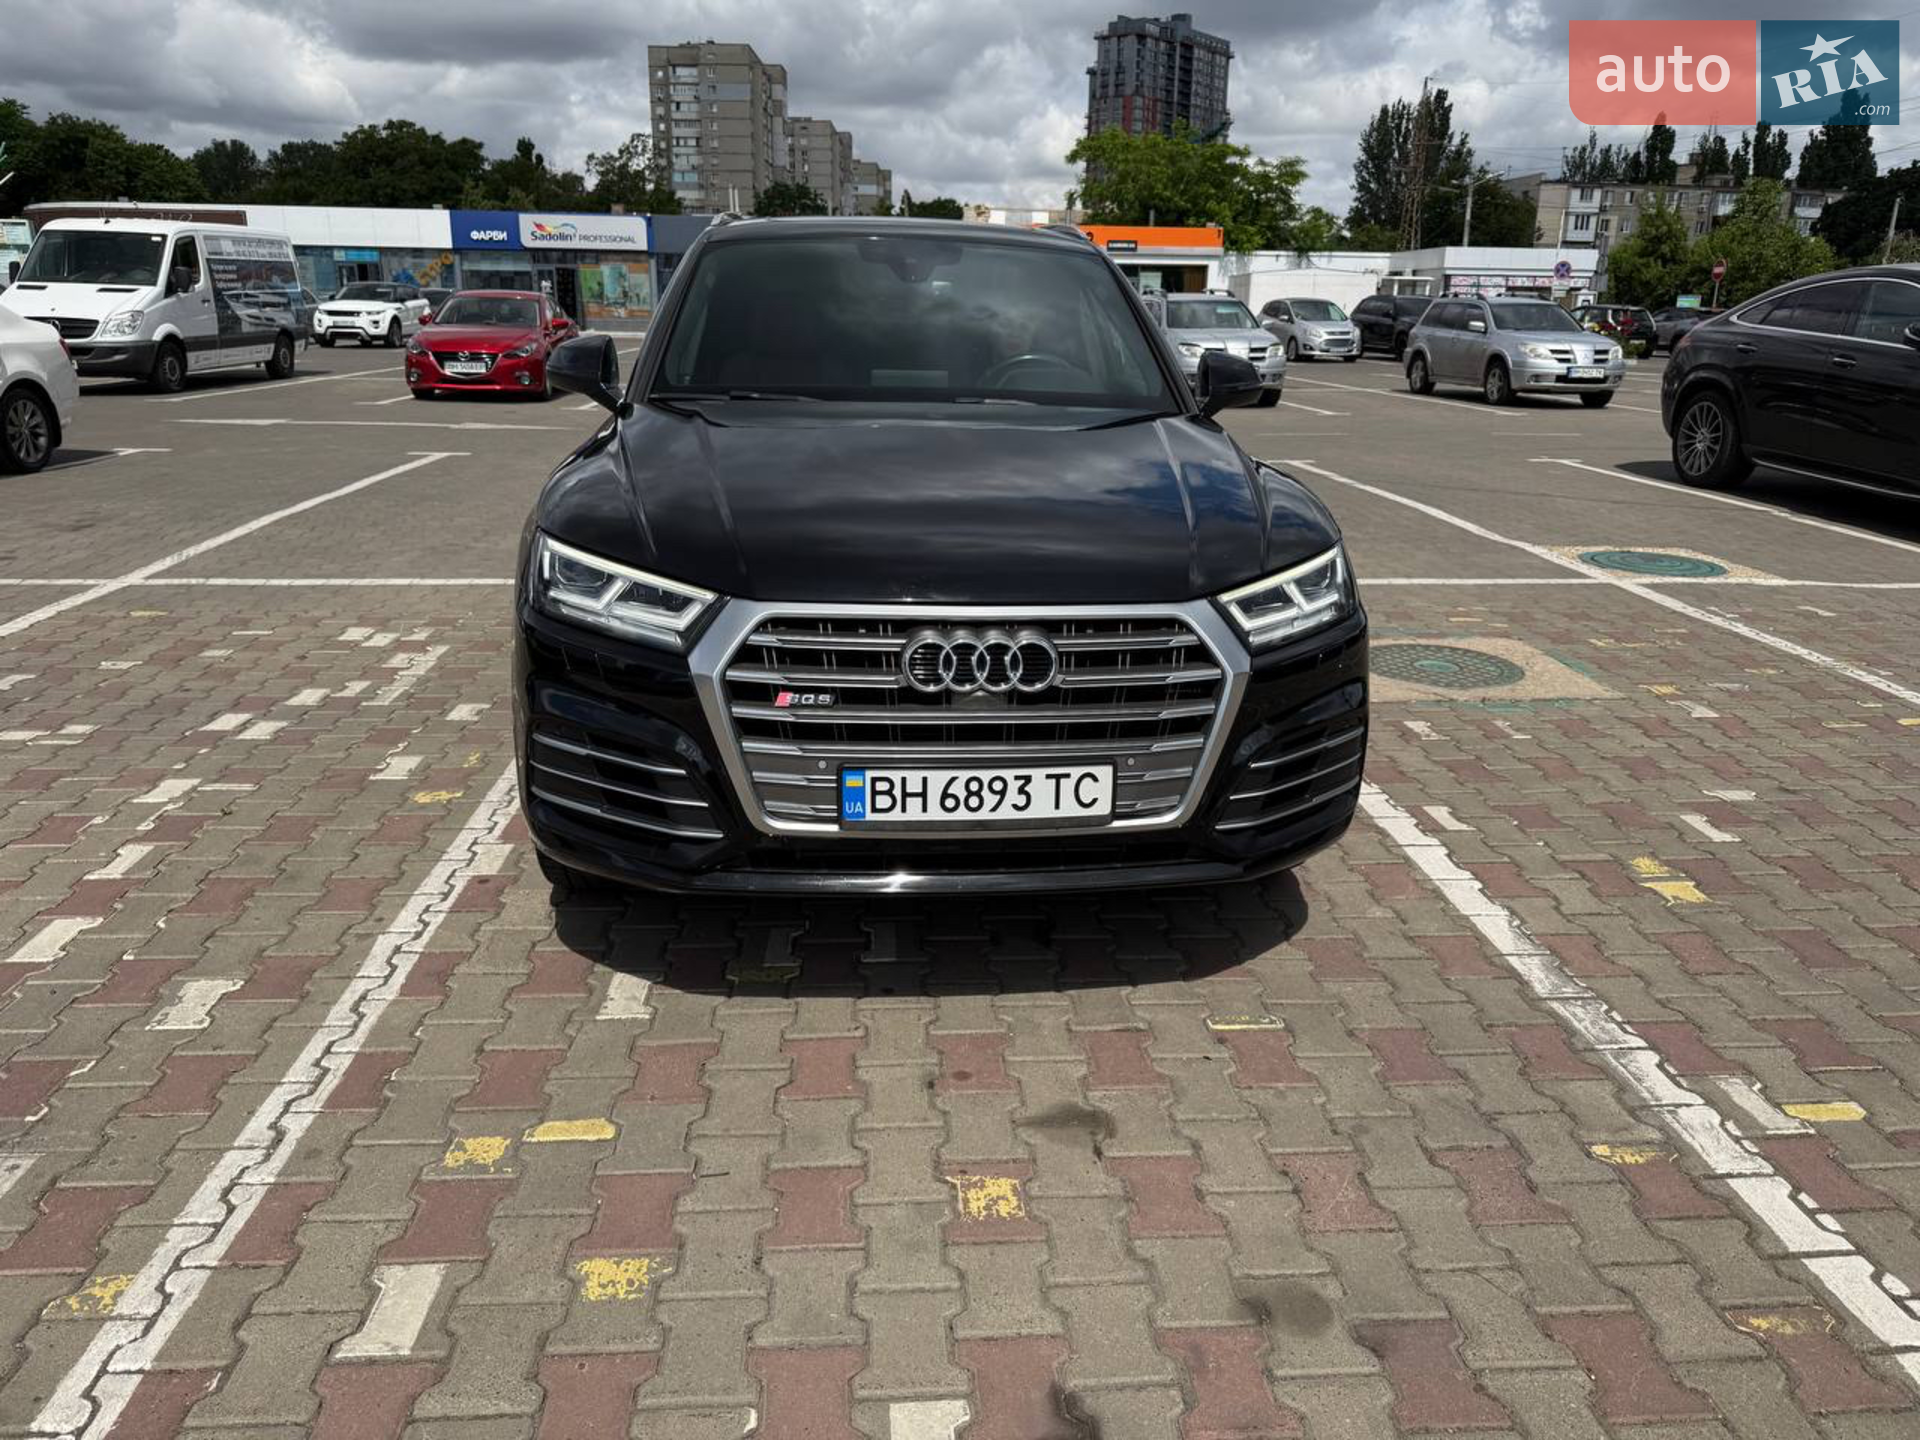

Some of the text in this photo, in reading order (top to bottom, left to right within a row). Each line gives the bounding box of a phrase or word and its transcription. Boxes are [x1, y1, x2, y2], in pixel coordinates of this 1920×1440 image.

[470, 230, 508, 241] ФАРБИ
[530, 230, 637, 244] Sadolin PROFESSIONAL
[870, 772, 1100, 813] BH 6893 TC
[845, 801, 864, 814] UA
